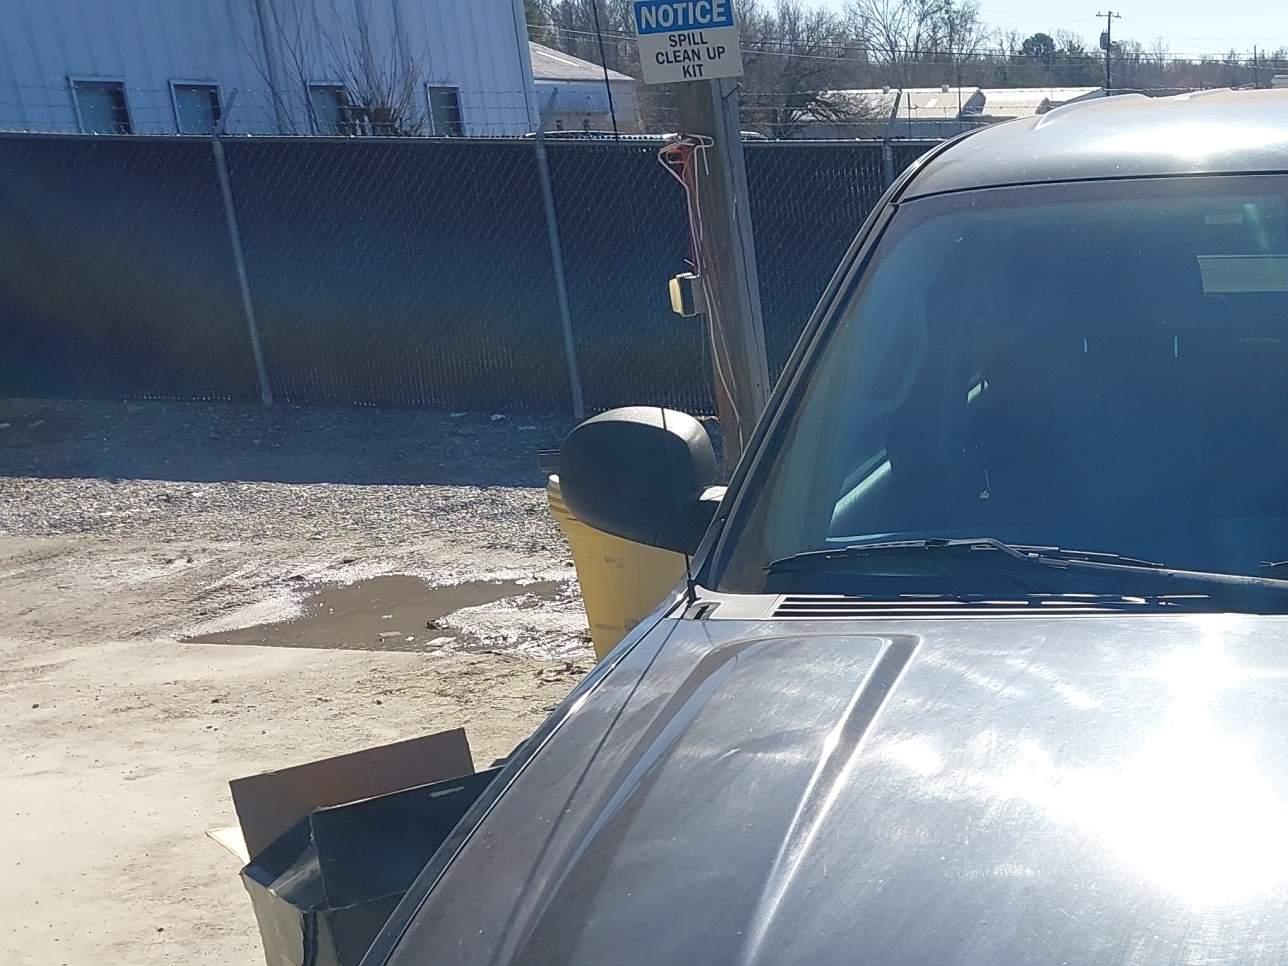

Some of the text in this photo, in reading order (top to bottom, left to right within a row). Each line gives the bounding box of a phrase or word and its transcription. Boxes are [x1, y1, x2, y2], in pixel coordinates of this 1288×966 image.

[640, 0, 726, 29] NOTICE
[668, 32, 708, 48] SPILL
[655, 46, 726, 65] CLEAN UP
[682, 64, 704, 78] KIT
